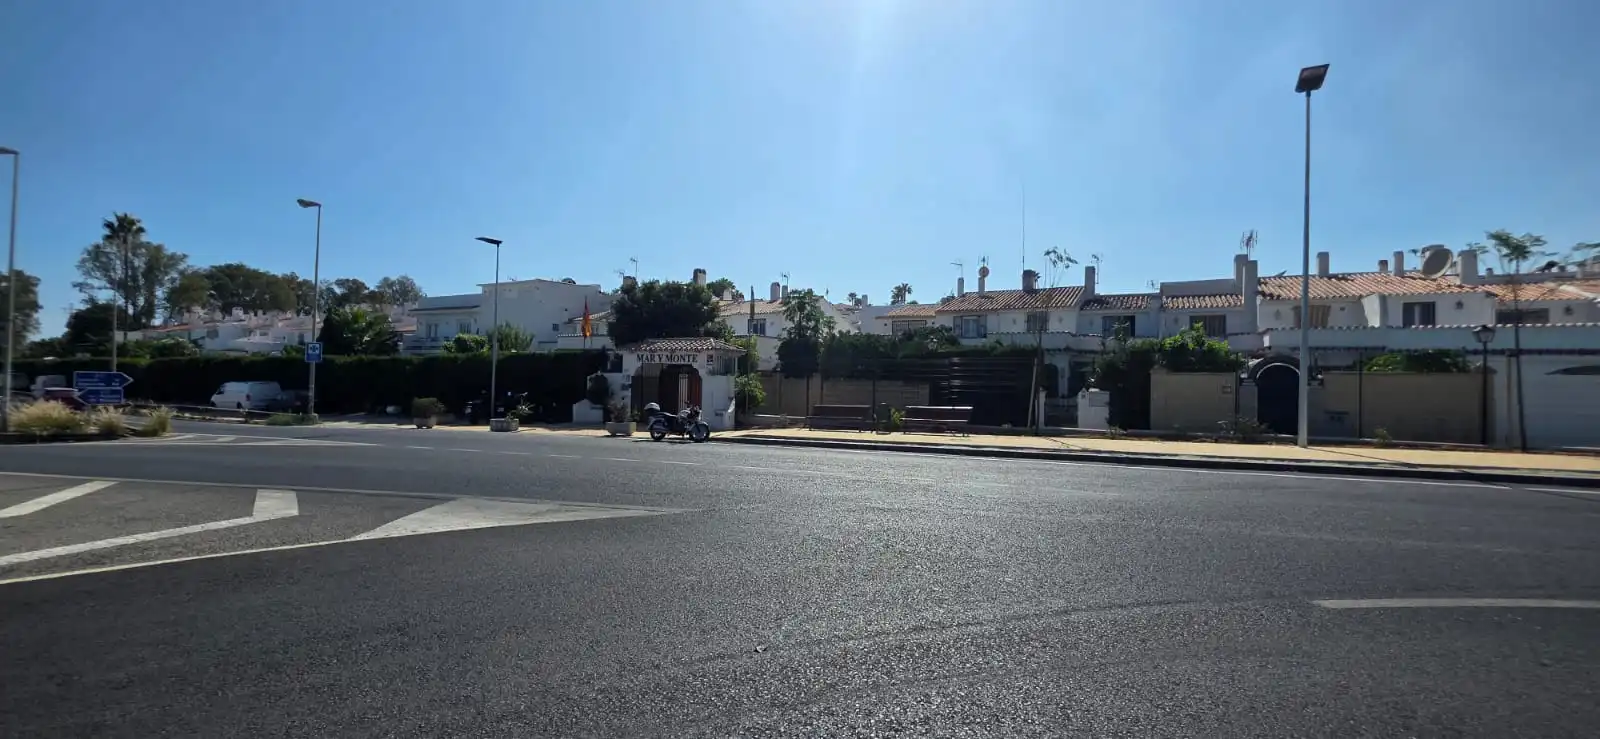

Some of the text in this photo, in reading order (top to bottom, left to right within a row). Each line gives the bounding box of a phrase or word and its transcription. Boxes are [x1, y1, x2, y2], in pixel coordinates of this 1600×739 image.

[637, 354, 698, 363] MAR Y MONTE
